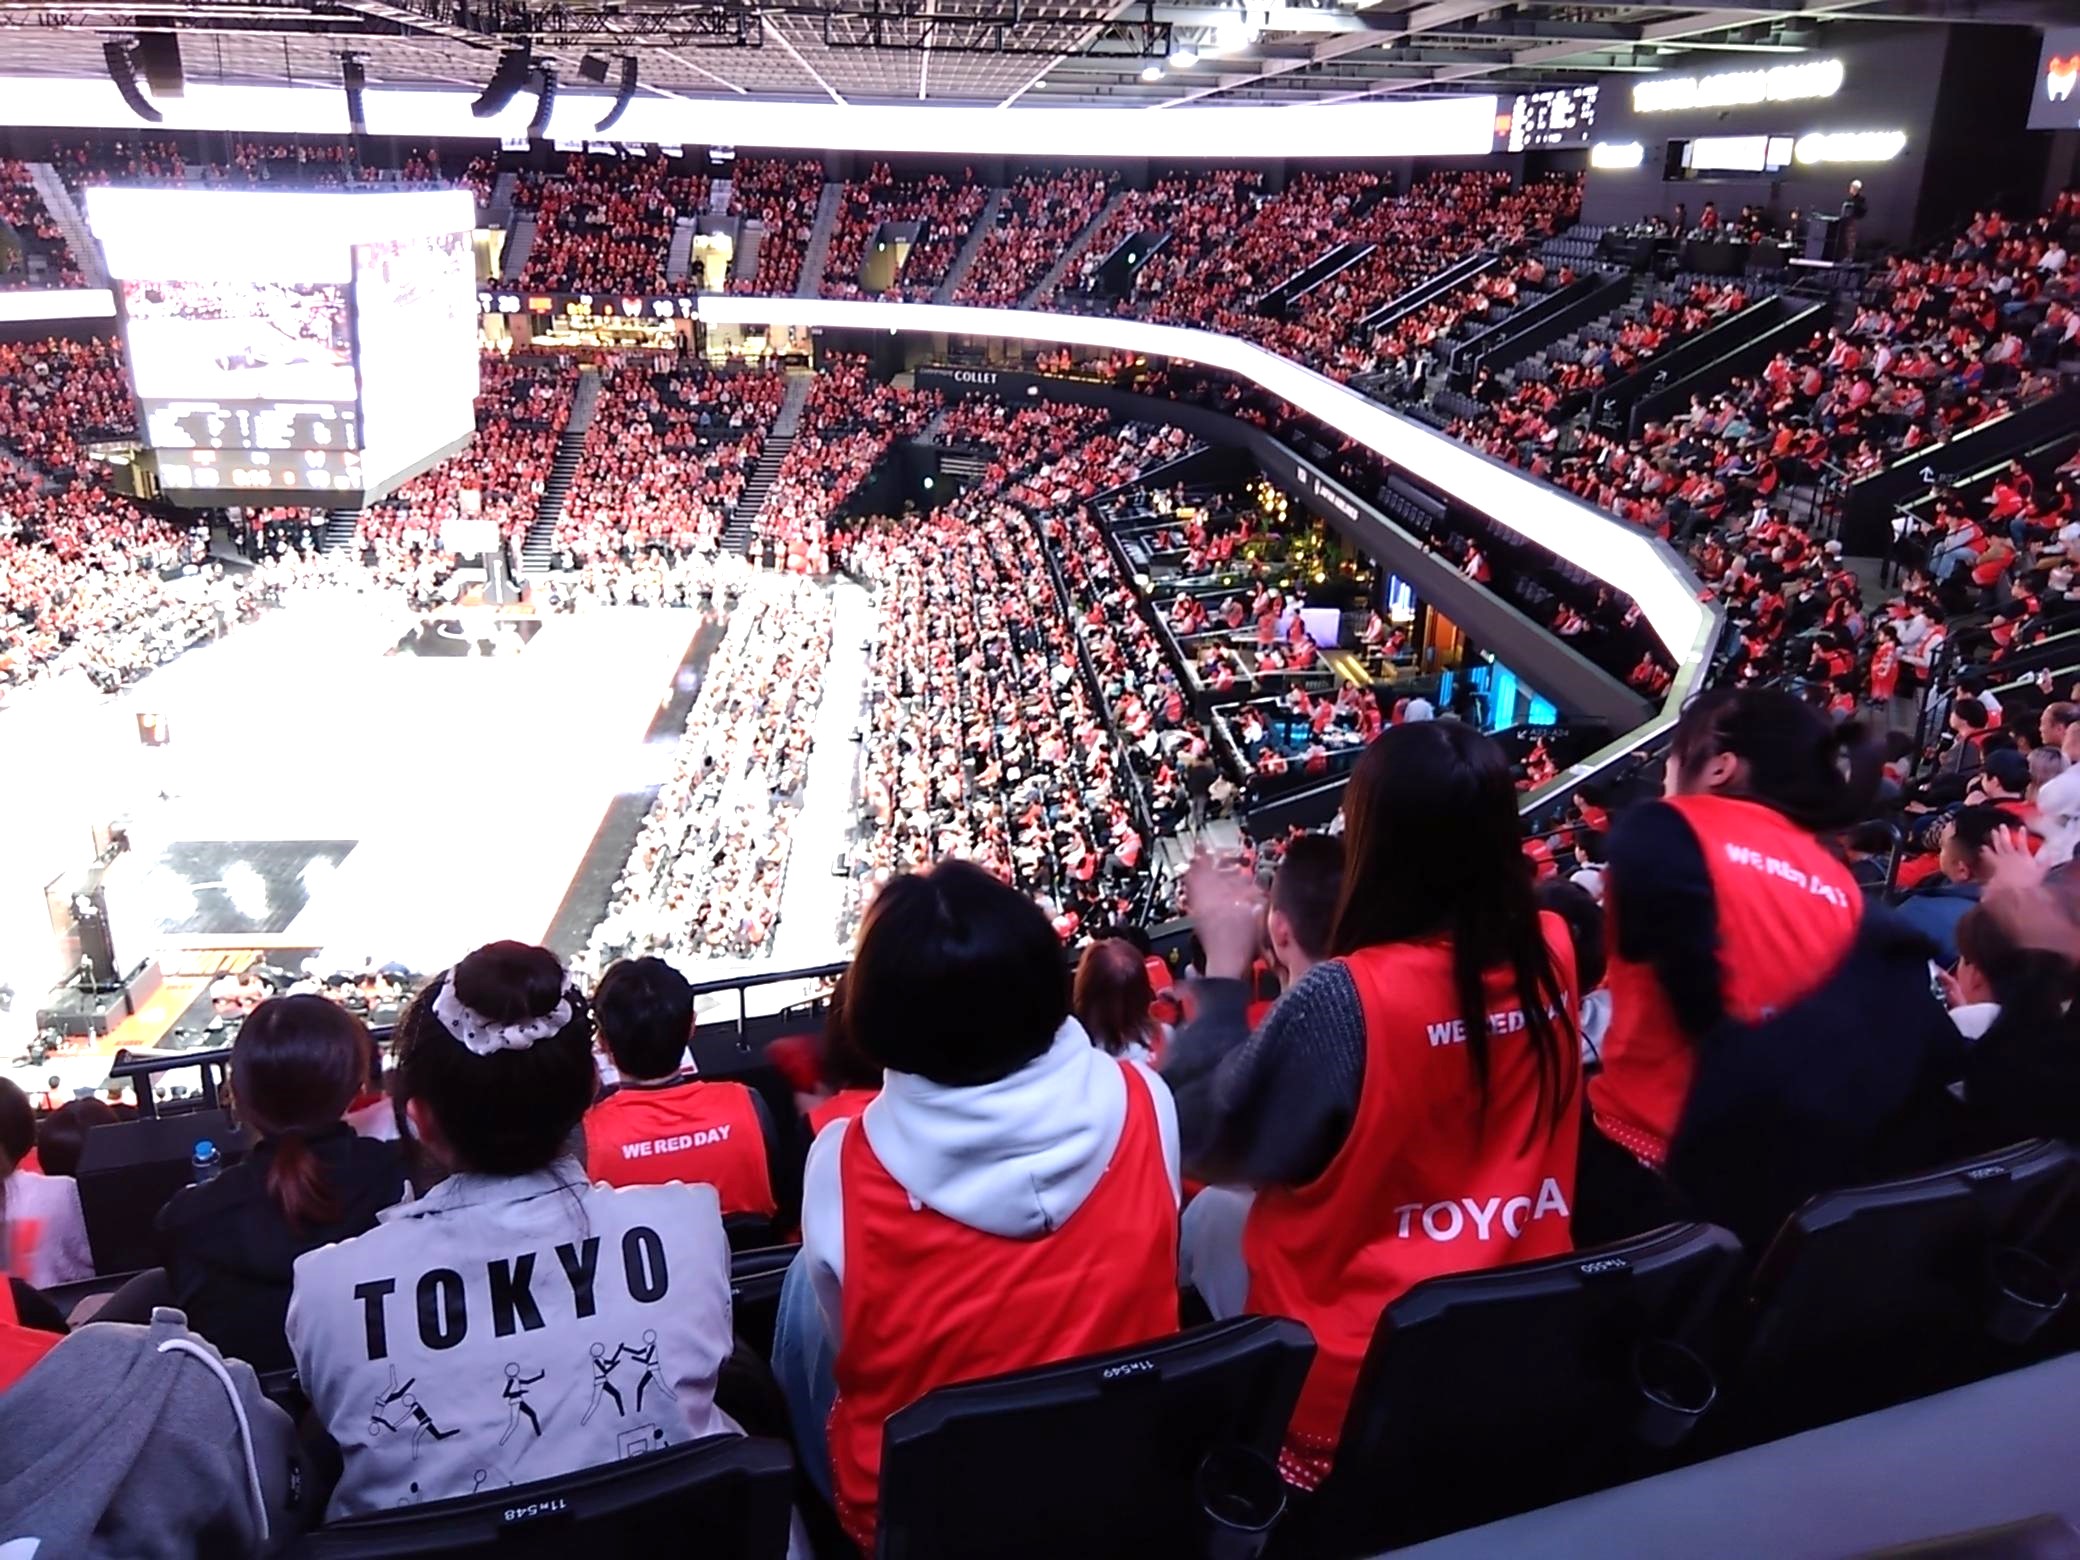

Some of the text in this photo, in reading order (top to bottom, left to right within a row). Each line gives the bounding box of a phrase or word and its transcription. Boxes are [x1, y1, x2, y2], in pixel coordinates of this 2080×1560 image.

[954, 371, 997, 384] COLLET
[1725, 843, 1763, 870] WE
[1427, 1019, 1467, 1047] WE
[622, 1125, 731, 1159] WE RED DAY
[1394, 1178, 1570, 1241] TOYOA
[354, 1226, 668, 1360] TOKYO
